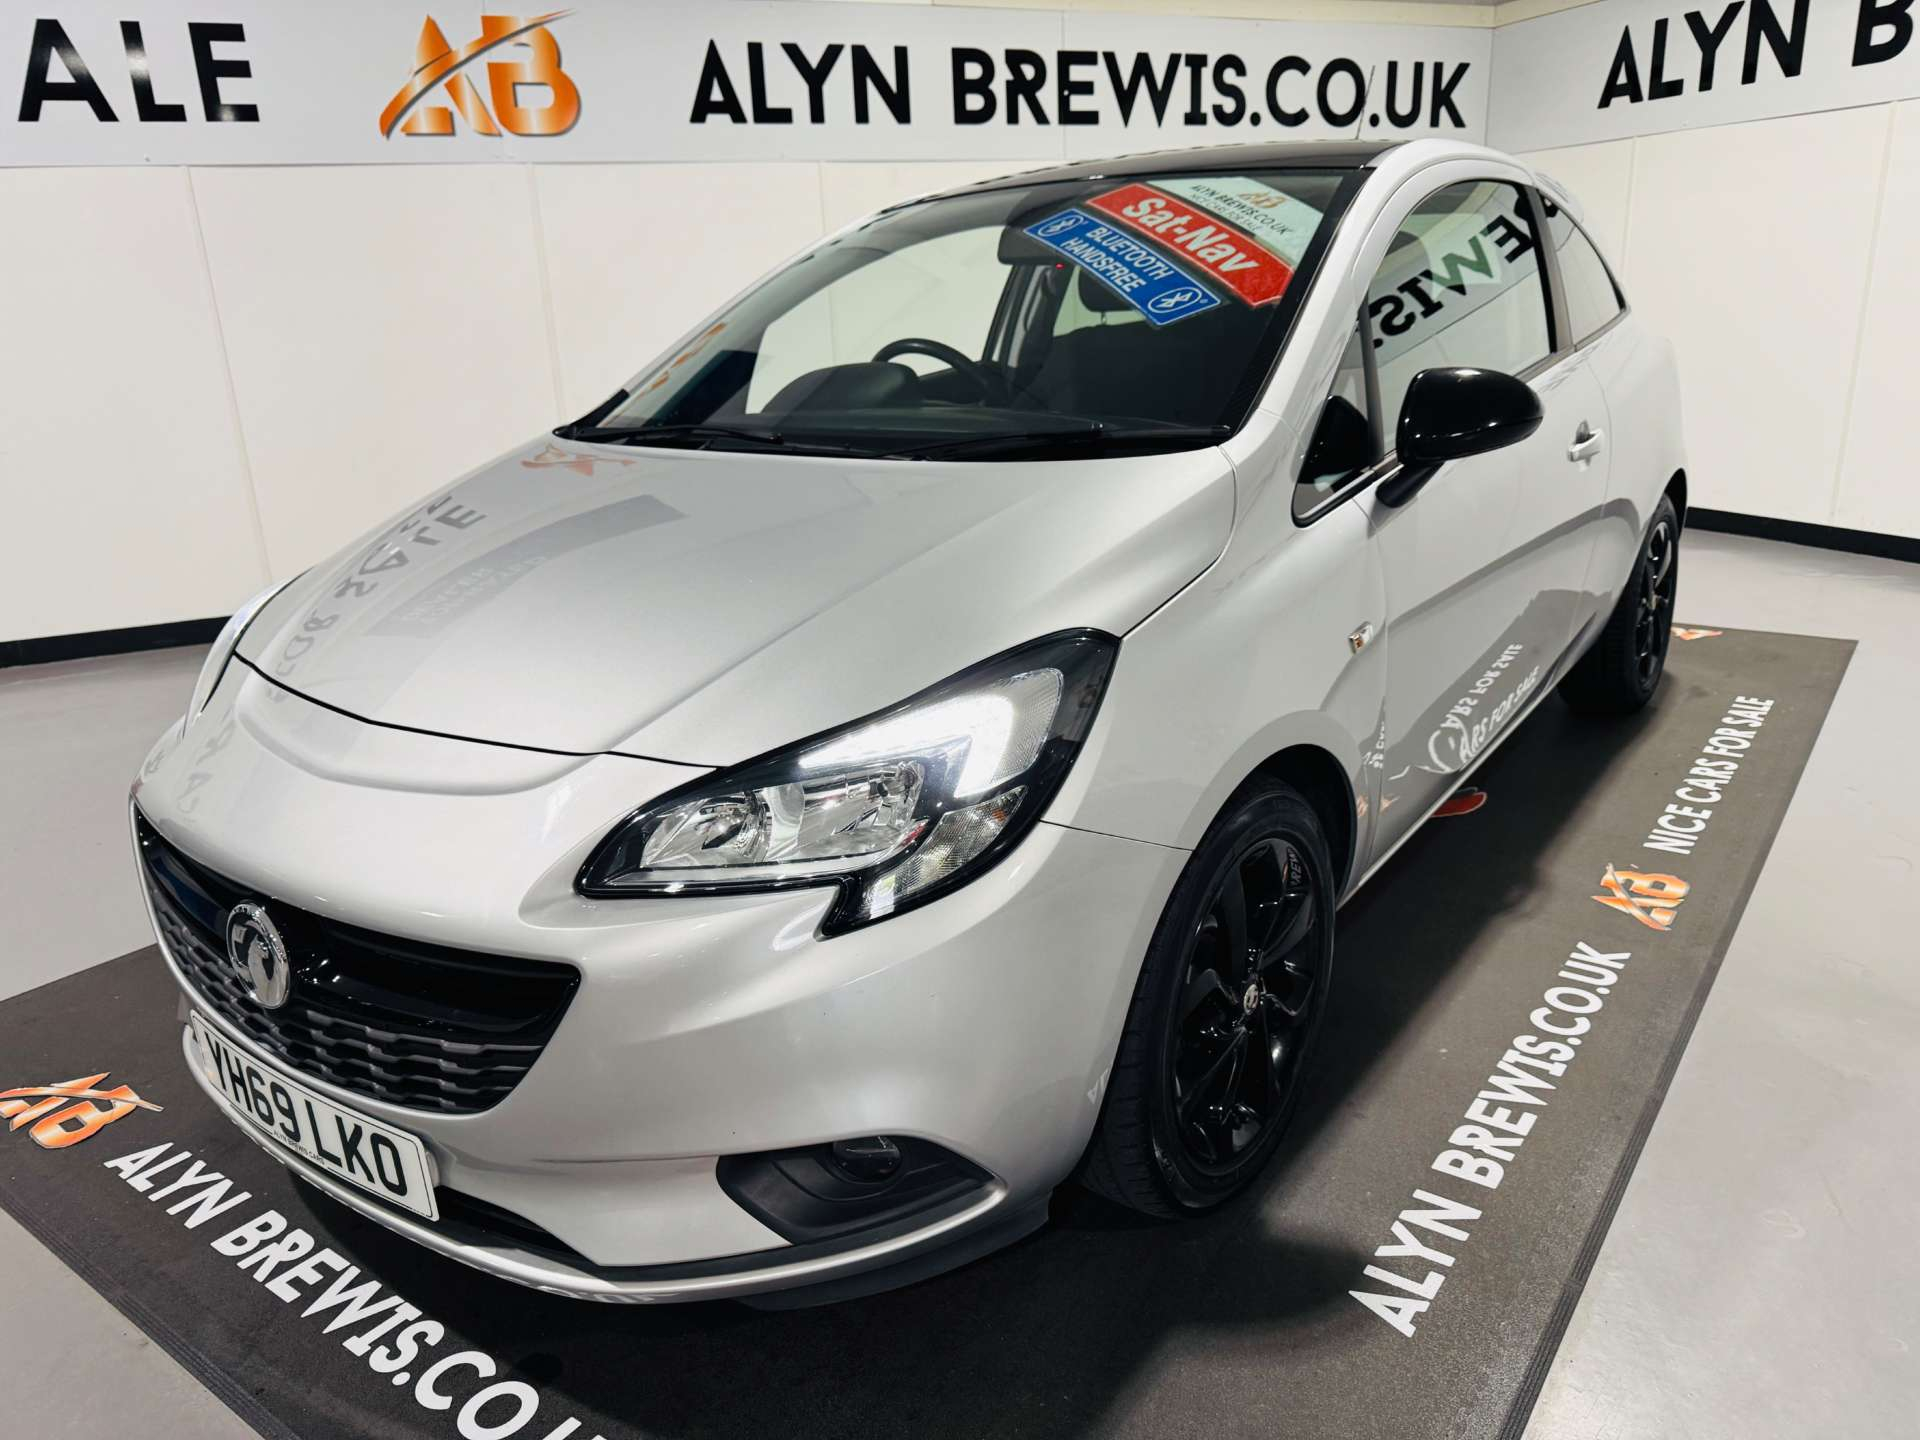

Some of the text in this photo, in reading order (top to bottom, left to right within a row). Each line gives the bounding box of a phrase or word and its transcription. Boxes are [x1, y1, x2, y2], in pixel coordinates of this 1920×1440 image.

[17, 18, 260, 122] ALE
[689, 39, 1470, 129] ALYN BREWIS.CO.UK
[1597, 0, 1809, 109] ALYN
[1060, 238, 1147, 293] HANDSFREE
[1086, 227, 1175, 281] BLUETOOTH
[1122, 197, 1260, 274] Sat-Nav
[1643, 696, 1775, 855] NICE CARS FOR SALE
[204, 1030, 408, 1197] YH69 LKO
[1348, 941, 1632, 1338] ALYN BREWIS.CO.UK
[104, 1142, 252, 1229] ALYN
